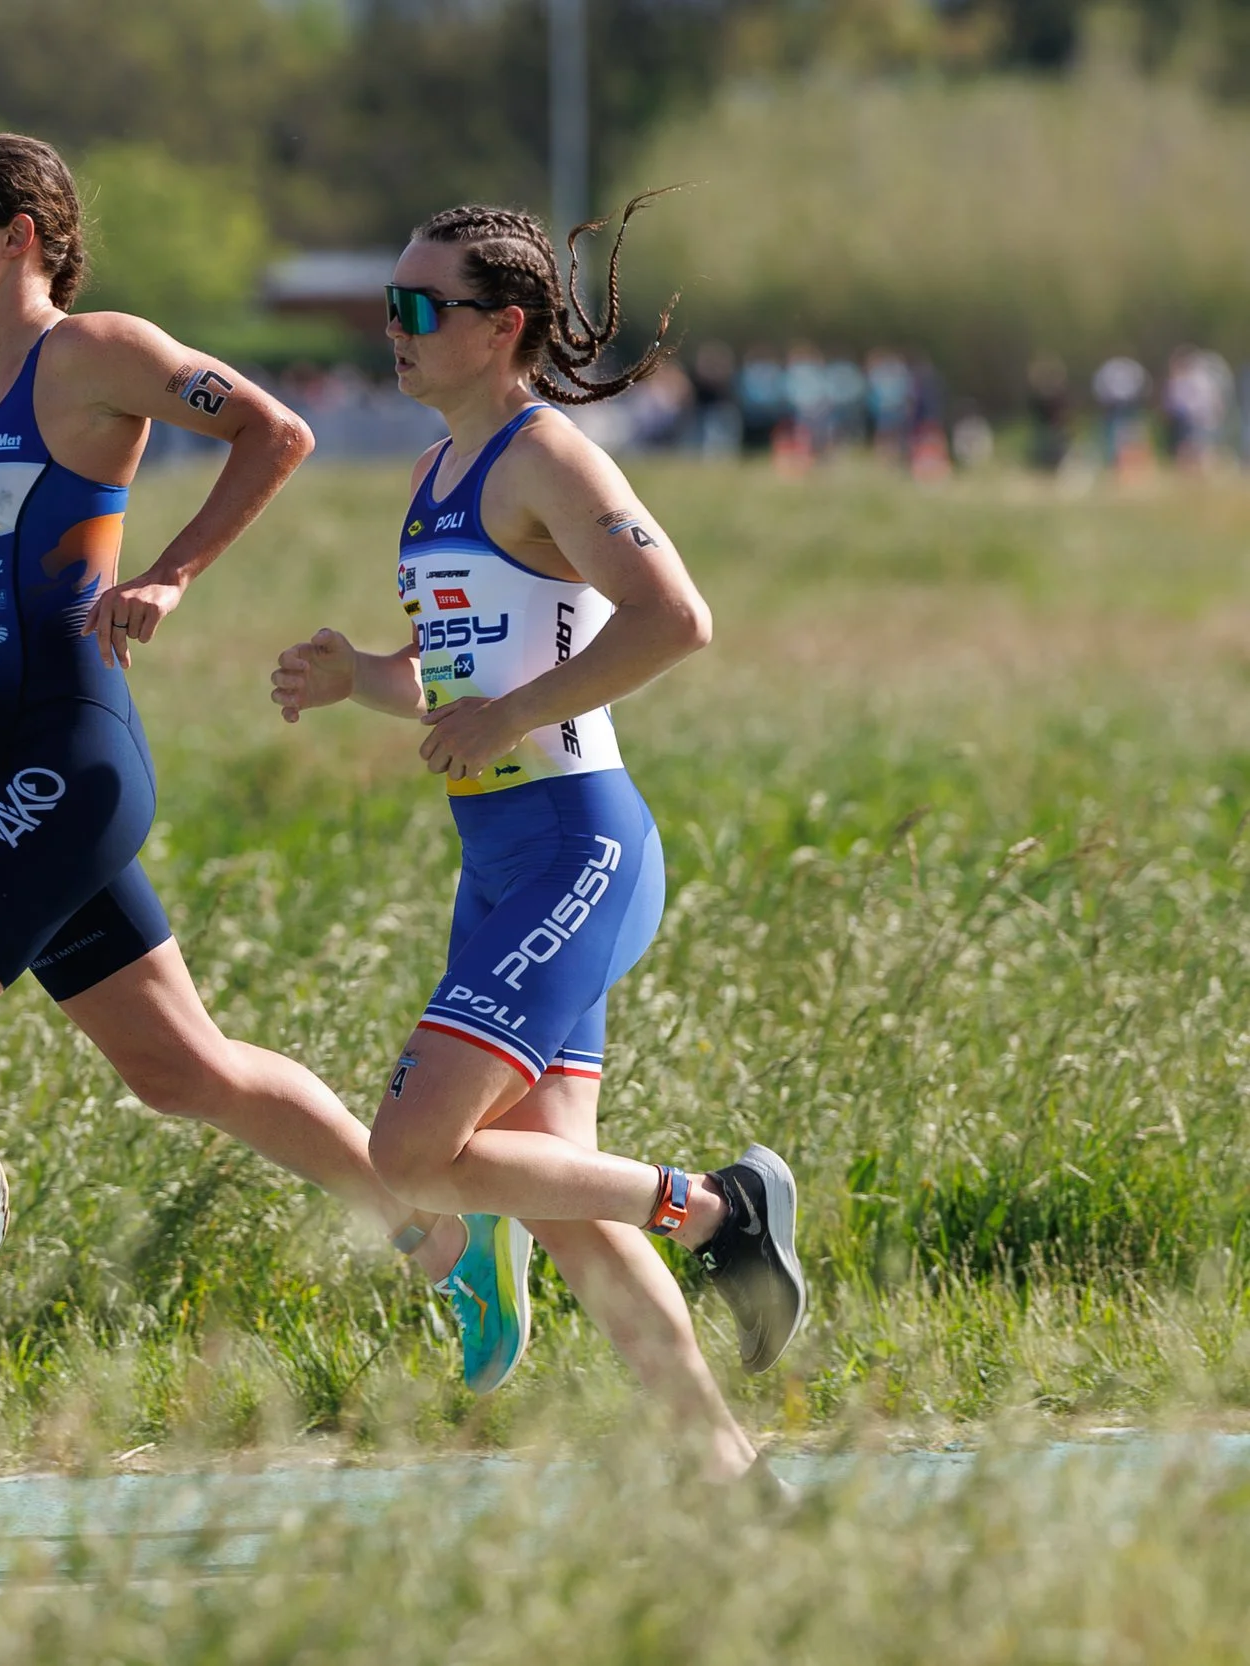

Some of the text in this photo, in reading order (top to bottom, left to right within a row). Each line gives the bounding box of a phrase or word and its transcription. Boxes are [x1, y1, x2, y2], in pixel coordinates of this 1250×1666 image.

[188, 369, 234, 416] 27
[434, 512, 465, 533] POLI
[630, 526, 659, 548] 4
[491, 834, 622, 991] POISSY
[445, 984, 527, 1031] POLI
[390, 1065, 409, 1100] 4
